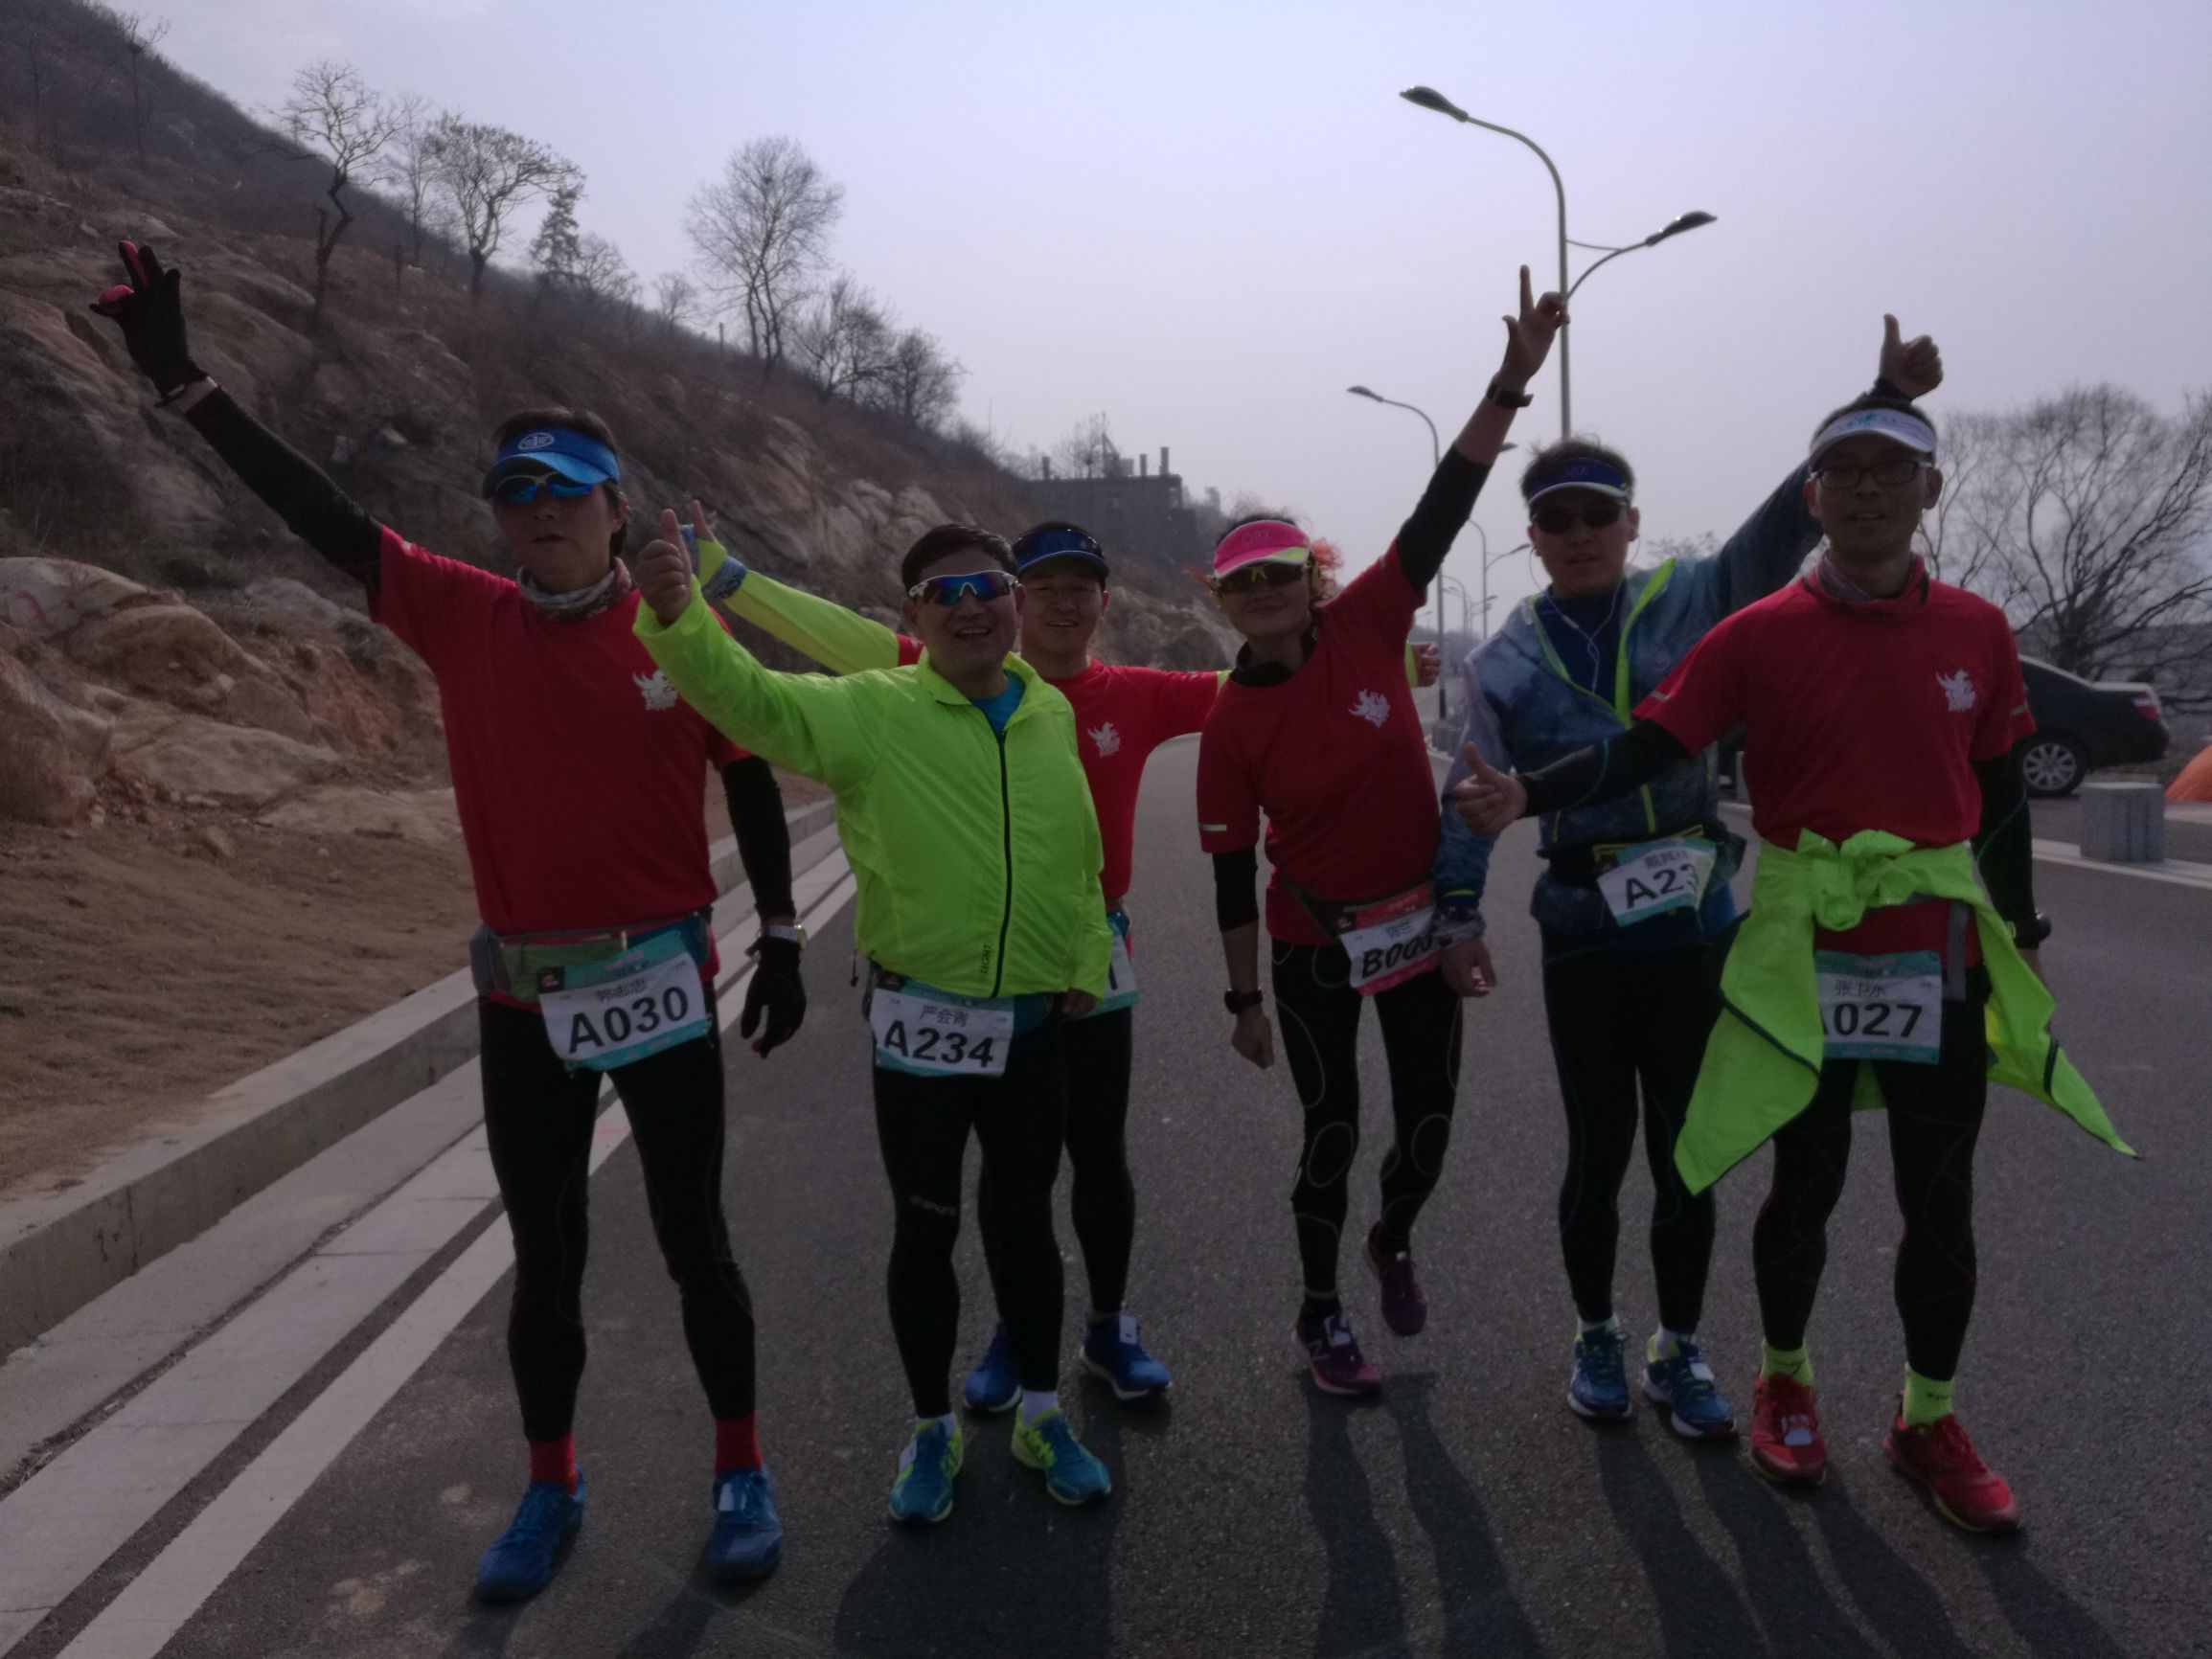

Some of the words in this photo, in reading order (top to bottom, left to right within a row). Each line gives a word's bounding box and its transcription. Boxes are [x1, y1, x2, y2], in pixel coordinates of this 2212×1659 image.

[569, 986, 689, 1054] A030
[883, 1020, 993, 1068] A234
[1821, 1003, 1922, 1037] 027
